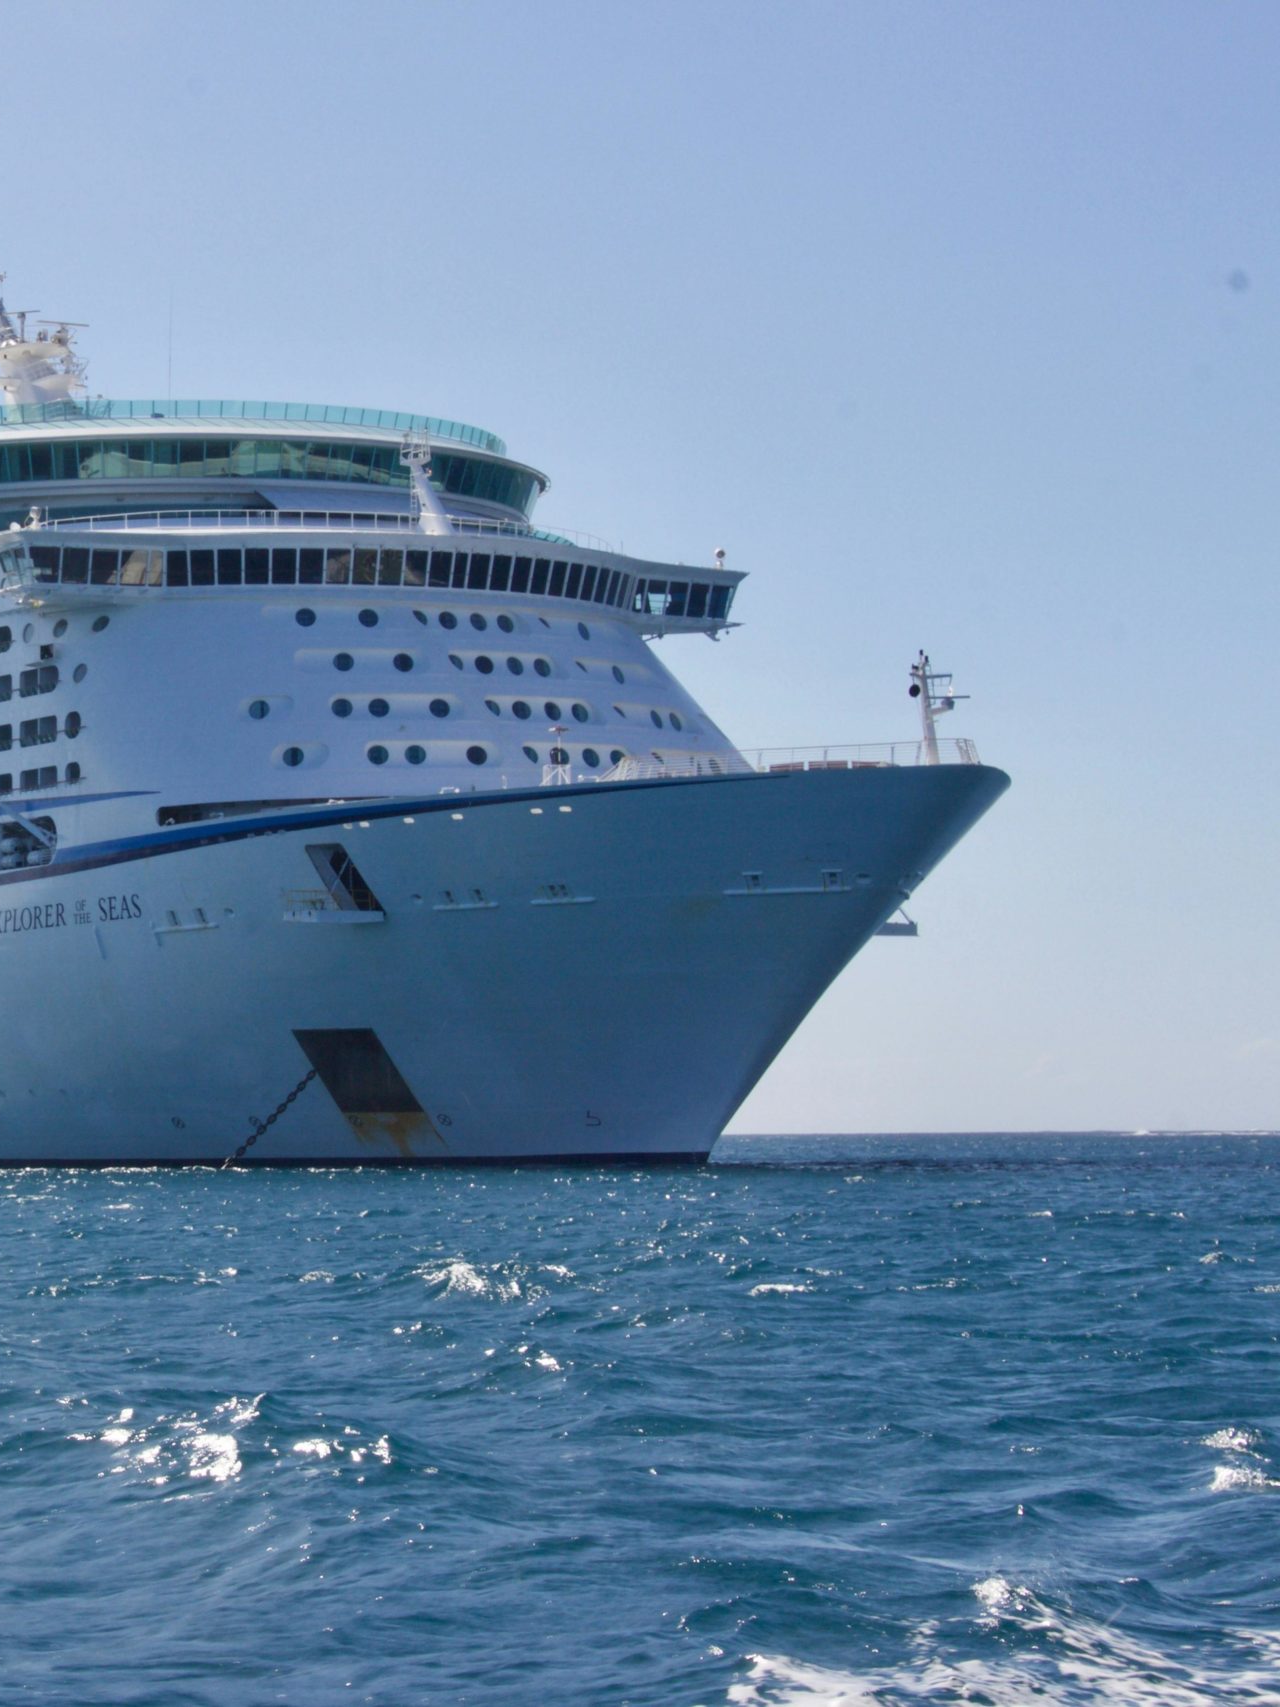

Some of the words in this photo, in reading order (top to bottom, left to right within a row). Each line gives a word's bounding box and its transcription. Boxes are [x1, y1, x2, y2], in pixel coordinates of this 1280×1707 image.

[75, 899, 87, 912] OF
[97, 894, 142, 922] SEAS
[73, 912, 92, 925] THE
